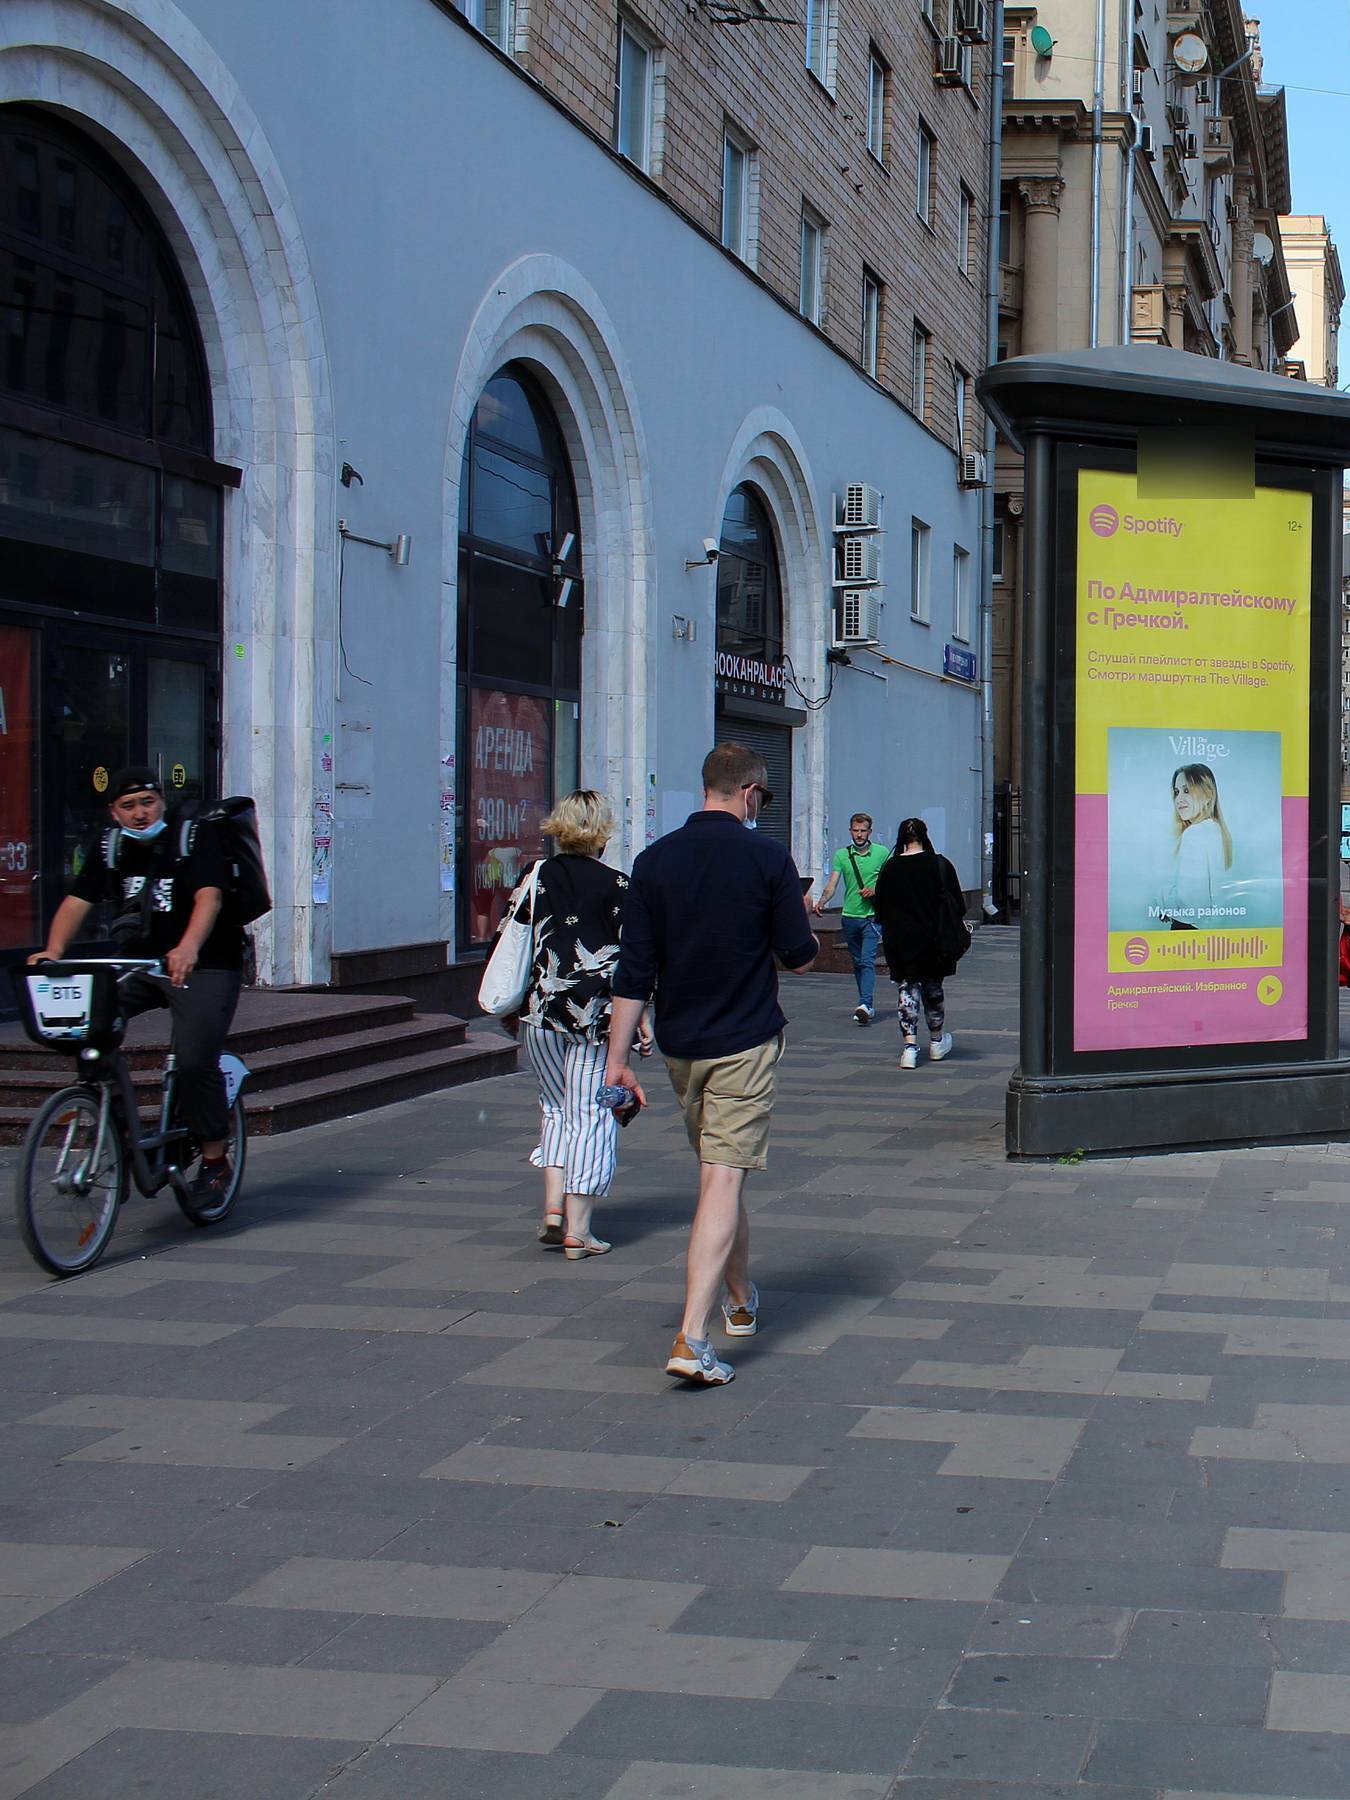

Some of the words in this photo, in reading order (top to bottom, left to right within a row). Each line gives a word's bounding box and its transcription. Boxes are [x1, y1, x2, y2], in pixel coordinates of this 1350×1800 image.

[1123, 514, 1183, 537] Spotify
[1288, 520, 1303, 531] 12+
[1087, 580, 1116, 600] По
[1119, 582, 1297, 615] Адмиралтейскому
[1087, 611, 1099, 625] с
[1103, 607, 1189, 631] Гречкой.
[1087, 650, 1136, 665] Слушай
[1138, 654, 1193, 666] плейлист
[1194, 658, 1208, 667] от
[1209, 658, 1250, 670] звезды
[1260, 658, 1297, 674] Spotify.
[1087, 667, 1137, 683] Смотри
[1138, 671, 1192, 685] маршрут
[1193, 674, 1207, 684] на
[1209, 672, 1230, 685] The
[1231, 673, 1269, 688] Village.
[475, 725, 534, 778] АРЕНДА
[1168, 735, 1231, 762] Village
[477, 797, 505, 841] 380
[1148, 905, 1195, 920] Музыка
[1197, 904, 1247, 919] районов
[53, 986, 82, 1000] ВТБ
[1107, 982, 1194, 996] Адмиралтейский.
[1195, 981, 1248, 993] Избранное
[1107, 999, 1139, 1011] Гречка
